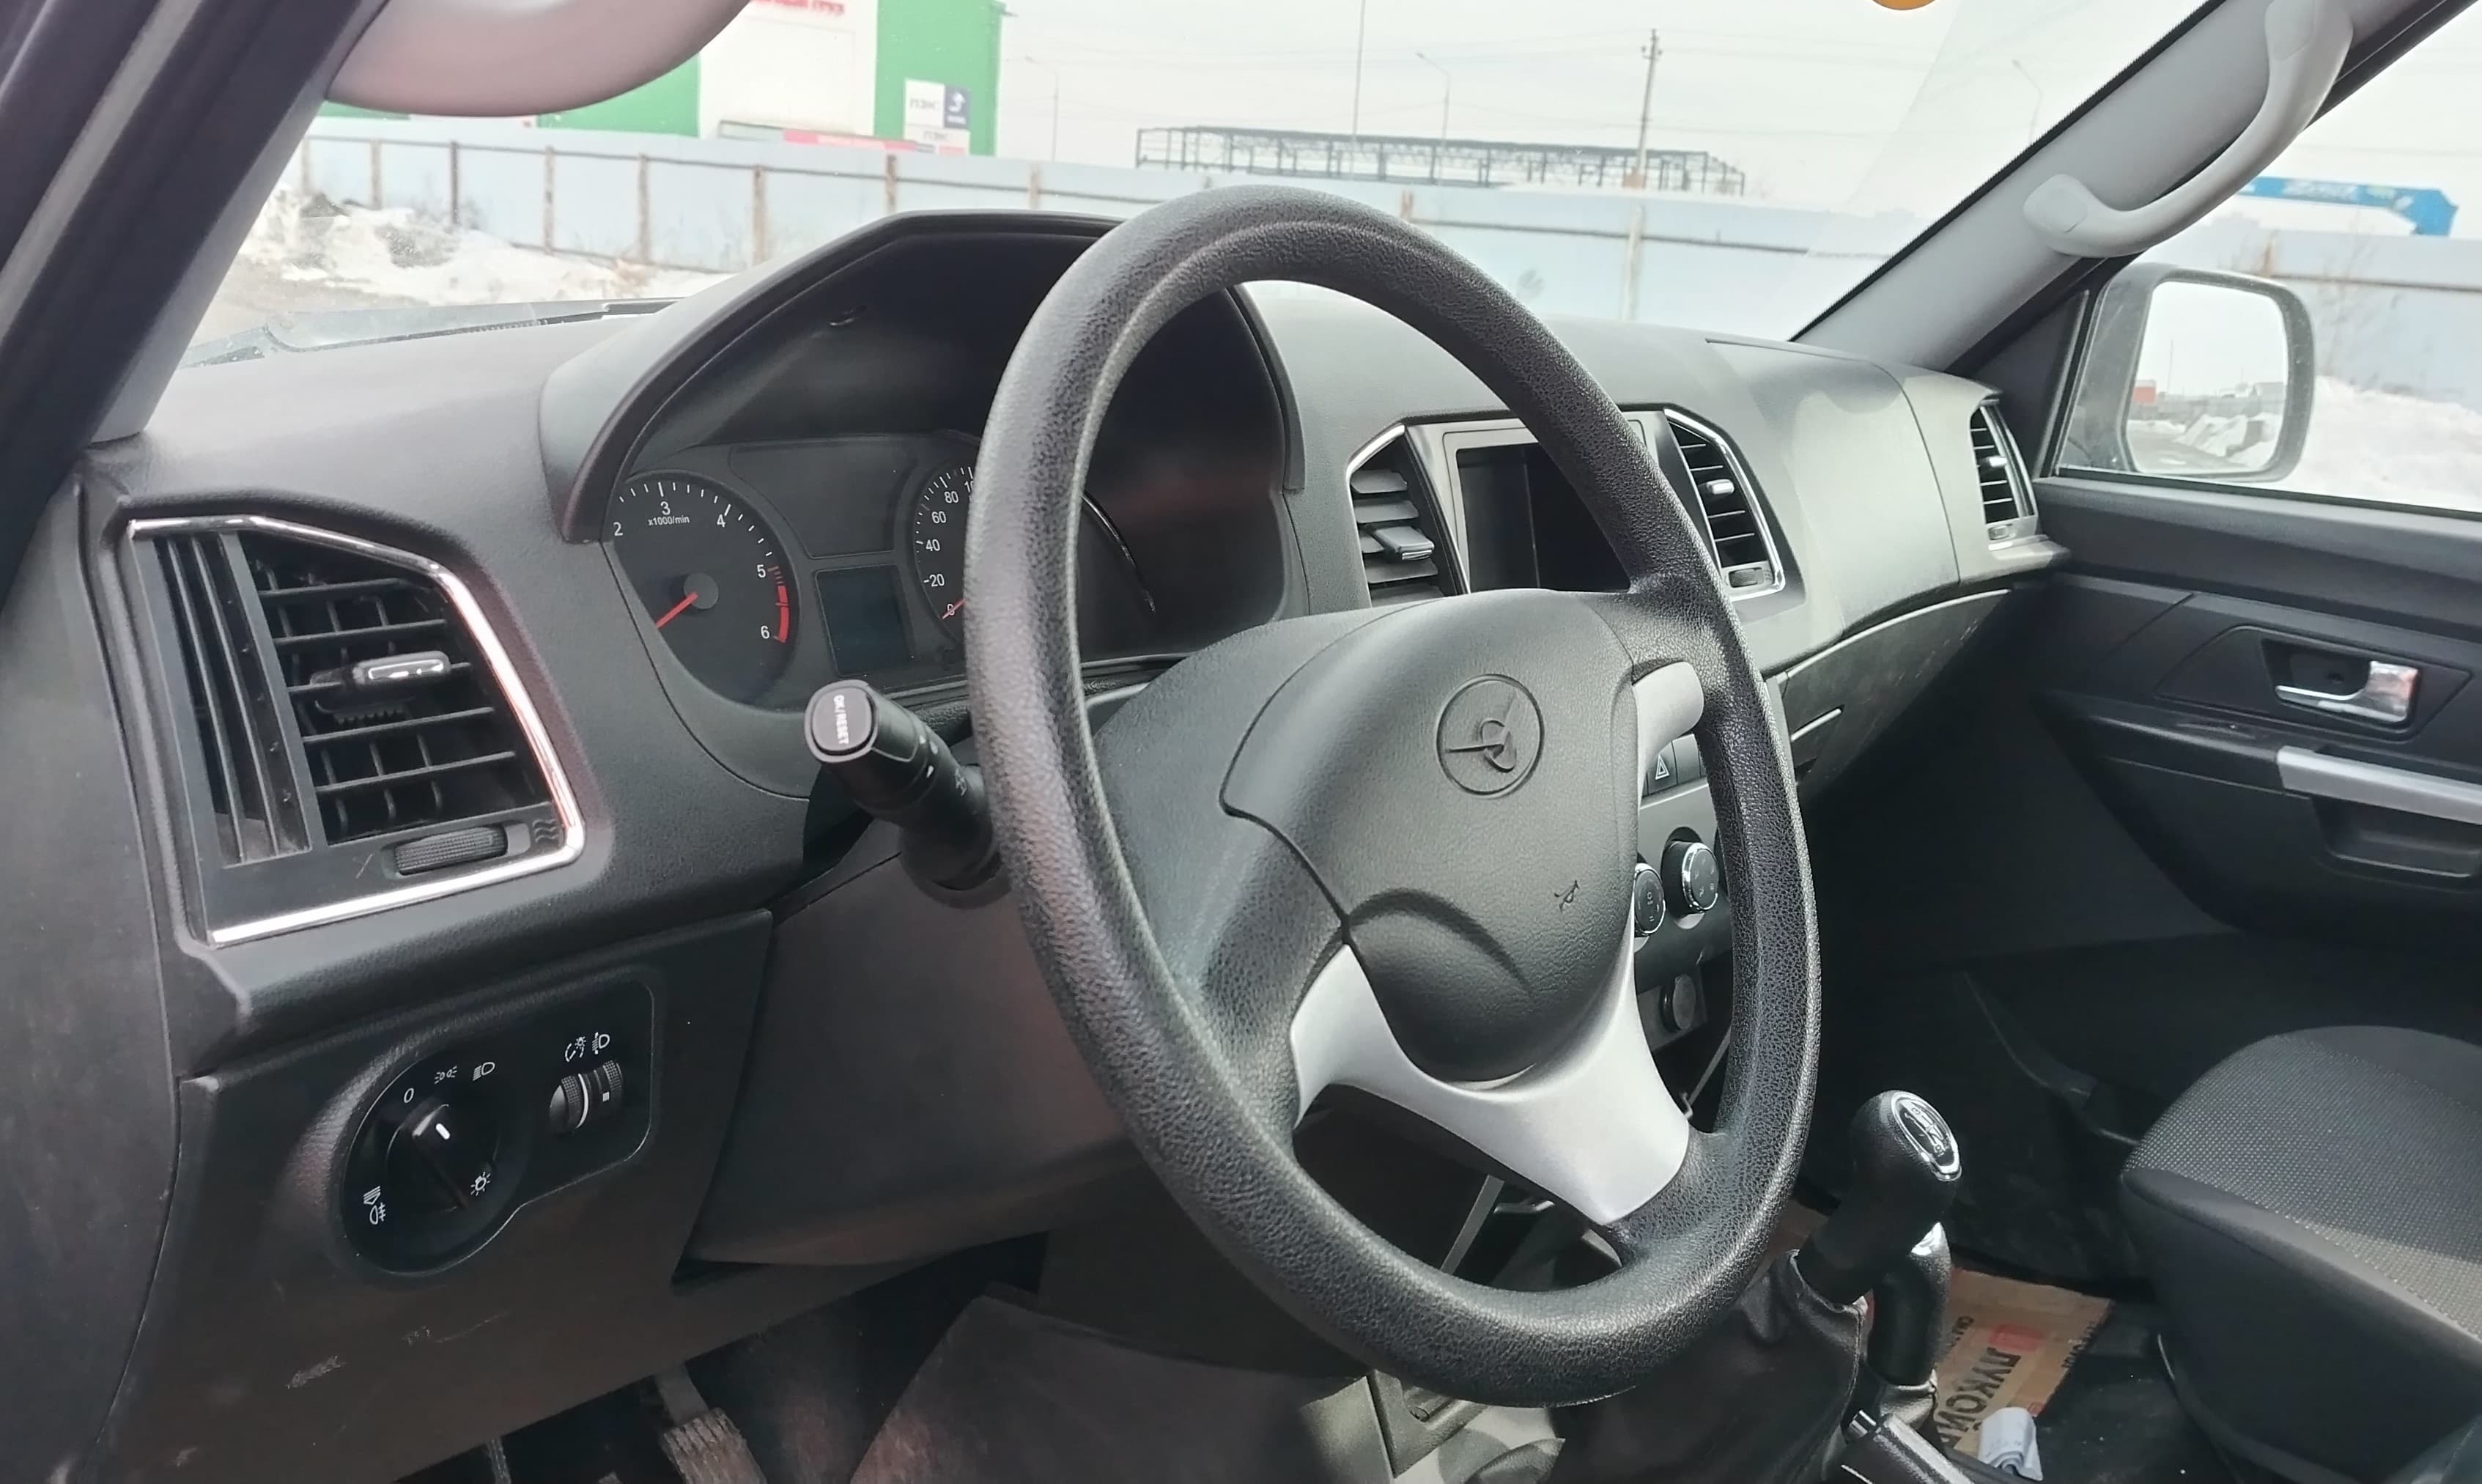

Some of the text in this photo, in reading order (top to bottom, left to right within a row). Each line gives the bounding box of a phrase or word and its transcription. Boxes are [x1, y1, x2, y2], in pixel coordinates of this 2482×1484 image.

[944, 491, 959, 503] 80
[660, 501, 671, 515] 3
[648, 514, 690, 526] x1000/min
[716, 514, 726, 528] 4
[931, 511, 947, 524] 60
[613, 521, 624, 536] 2
[926, 539, 941, 551] 40
[756, 564, 767, 578] 5
[760, 625, 770, 639] 6
[404, 1088, 415, 1104] 0
